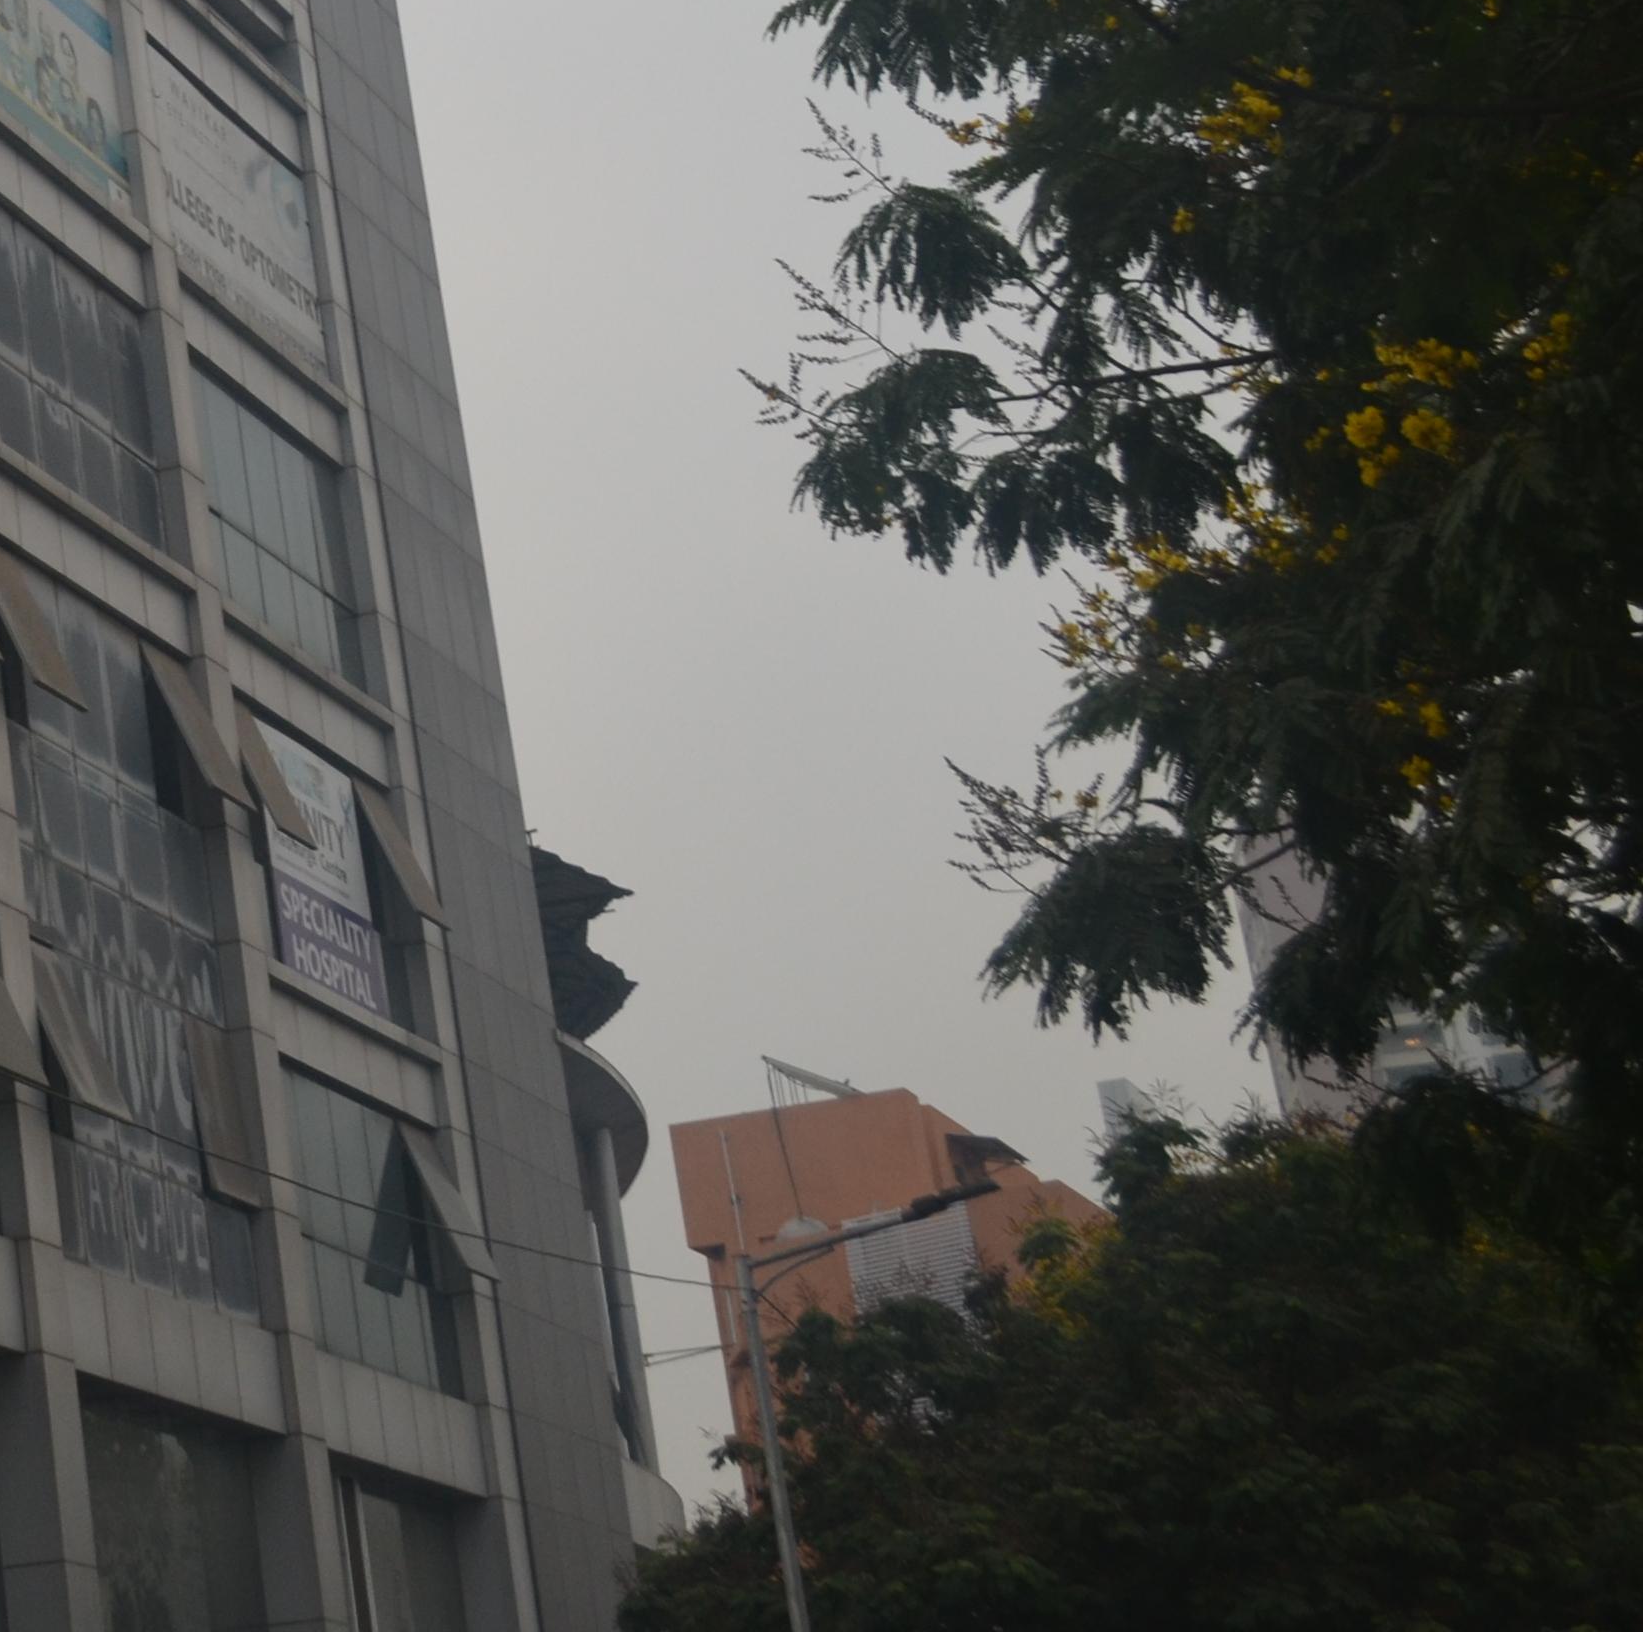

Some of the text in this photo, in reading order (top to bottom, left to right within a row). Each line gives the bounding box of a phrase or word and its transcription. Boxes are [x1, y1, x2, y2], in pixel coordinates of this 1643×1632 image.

[166, 169, 216, 239] LLEGE
[217, 215, 236, 255] OF
[281, 882, 372, 966] SPECIALITY
[292, 933, 377, 1010] HOSPITAL
